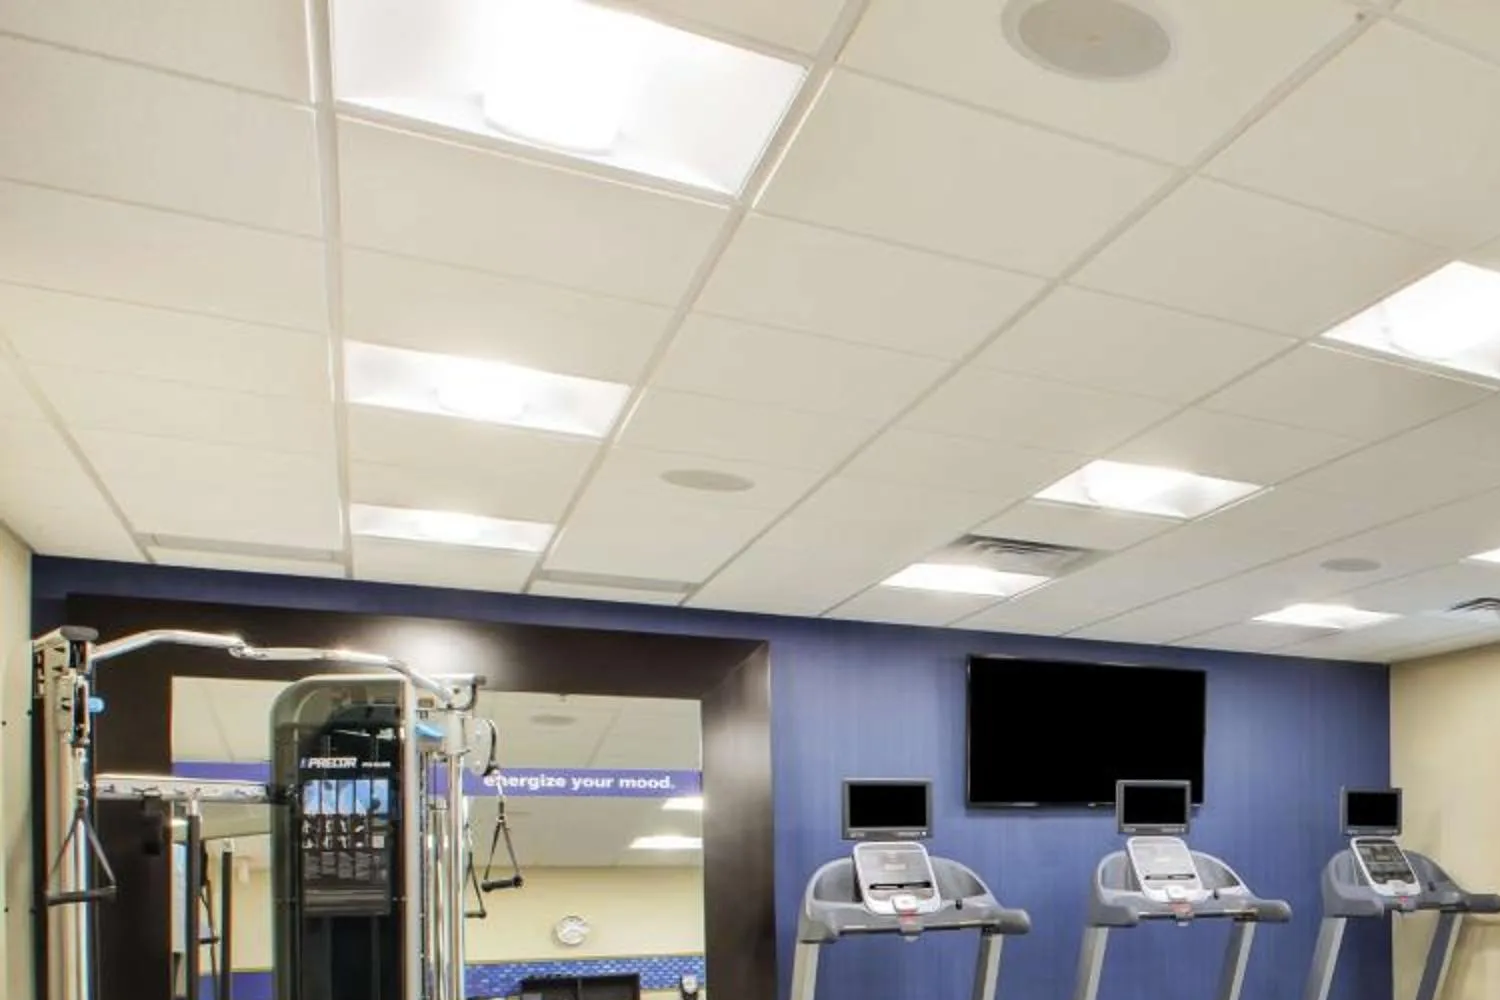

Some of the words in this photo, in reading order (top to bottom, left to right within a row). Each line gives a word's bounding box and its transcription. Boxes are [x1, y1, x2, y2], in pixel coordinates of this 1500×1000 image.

[307, 757, 357, 769] PRECOR
[483, 774, 566, 791] energize
[571, 777, 614, 791] your
[619, 775, 676, 789] mood.
